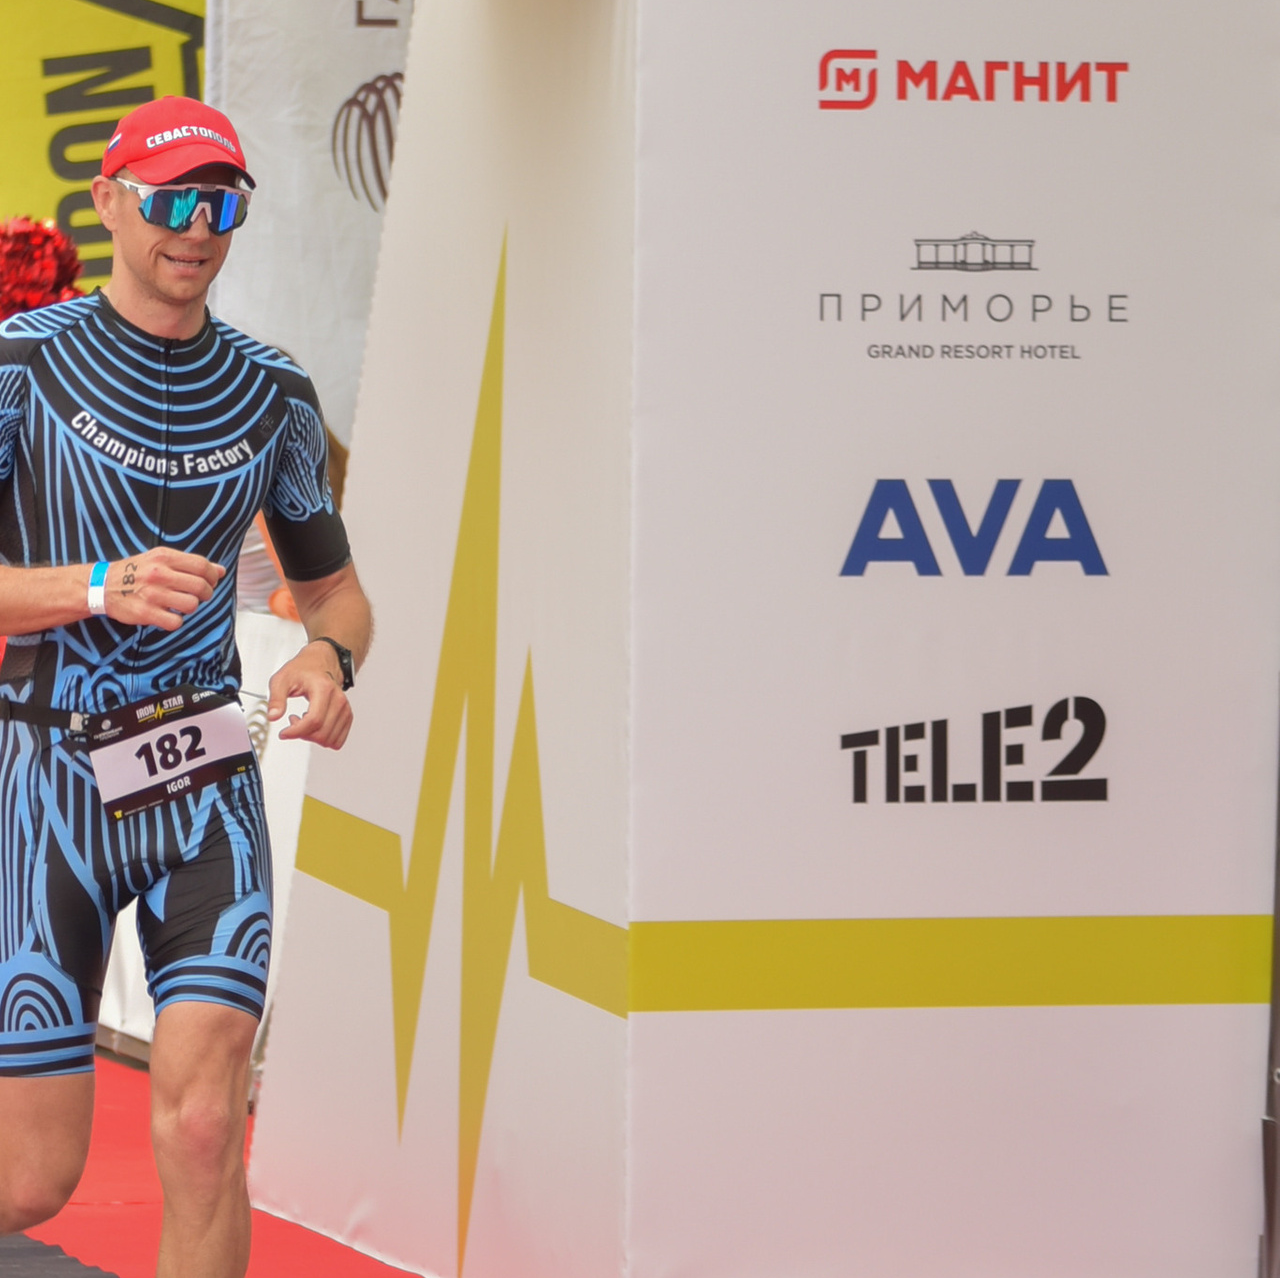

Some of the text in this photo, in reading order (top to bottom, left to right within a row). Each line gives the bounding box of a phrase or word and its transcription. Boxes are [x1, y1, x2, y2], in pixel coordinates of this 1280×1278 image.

[895, 60, 1130, 103] МАГНИТ
[145, 125, 237, 154] СЕВАСТОПОЛЬ
[819, 293, 1129, 323] ПРИМОРЬЕ
[866, 343, 1081, 360] GRAND RESORT HOTEL
[70, 410, 254, 476] Champions Factory
[838, 478, 1110, 576] AVA
[121, 562, 138, 597] 182
[135, 703, 155, 720] IRON
[162, 694, 185, 710] STAR
[134, 725, 207, 778] 182
[839, 695, 1110, 804] TELE2
[166, 775, 192, 794] IGOR
